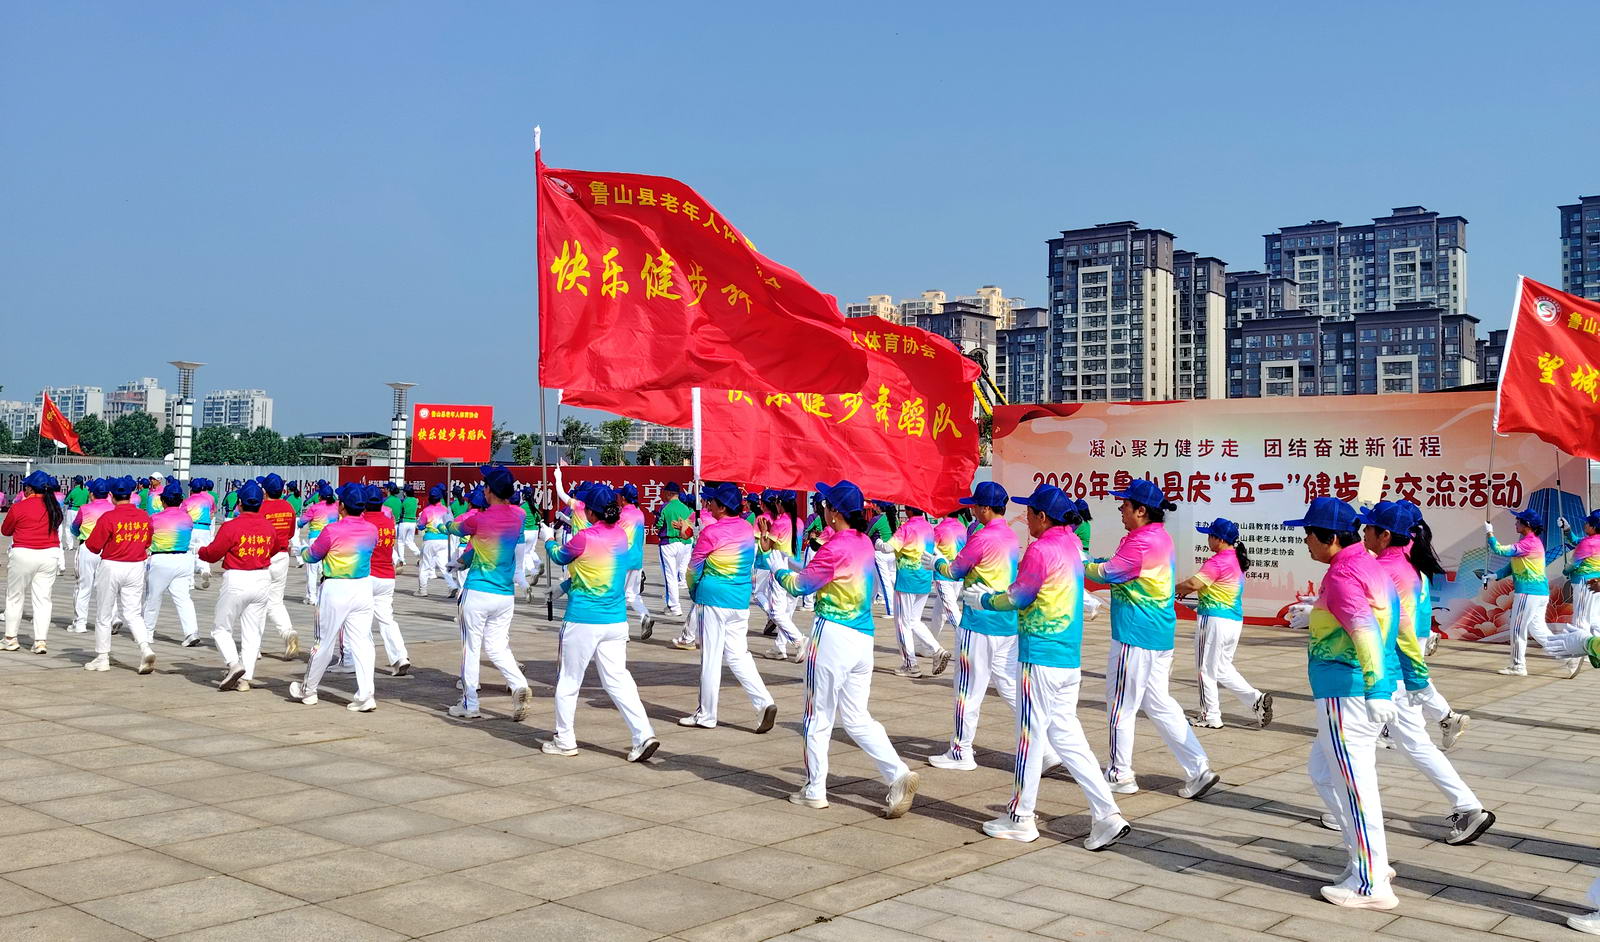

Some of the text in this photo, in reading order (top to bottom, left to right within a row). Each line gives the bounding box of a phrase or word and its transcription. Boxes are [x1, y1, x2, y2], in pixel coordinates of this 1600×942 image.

[1567, 311, 1600, 337] 鲁山
[1088, 436, 1441, 458] 凝心聚力健步走 团结奋进新征程
[1238, 535, 1303, 544] 山县老年人体育协
[1247, 548, 1295, 556] 县健步走协会
